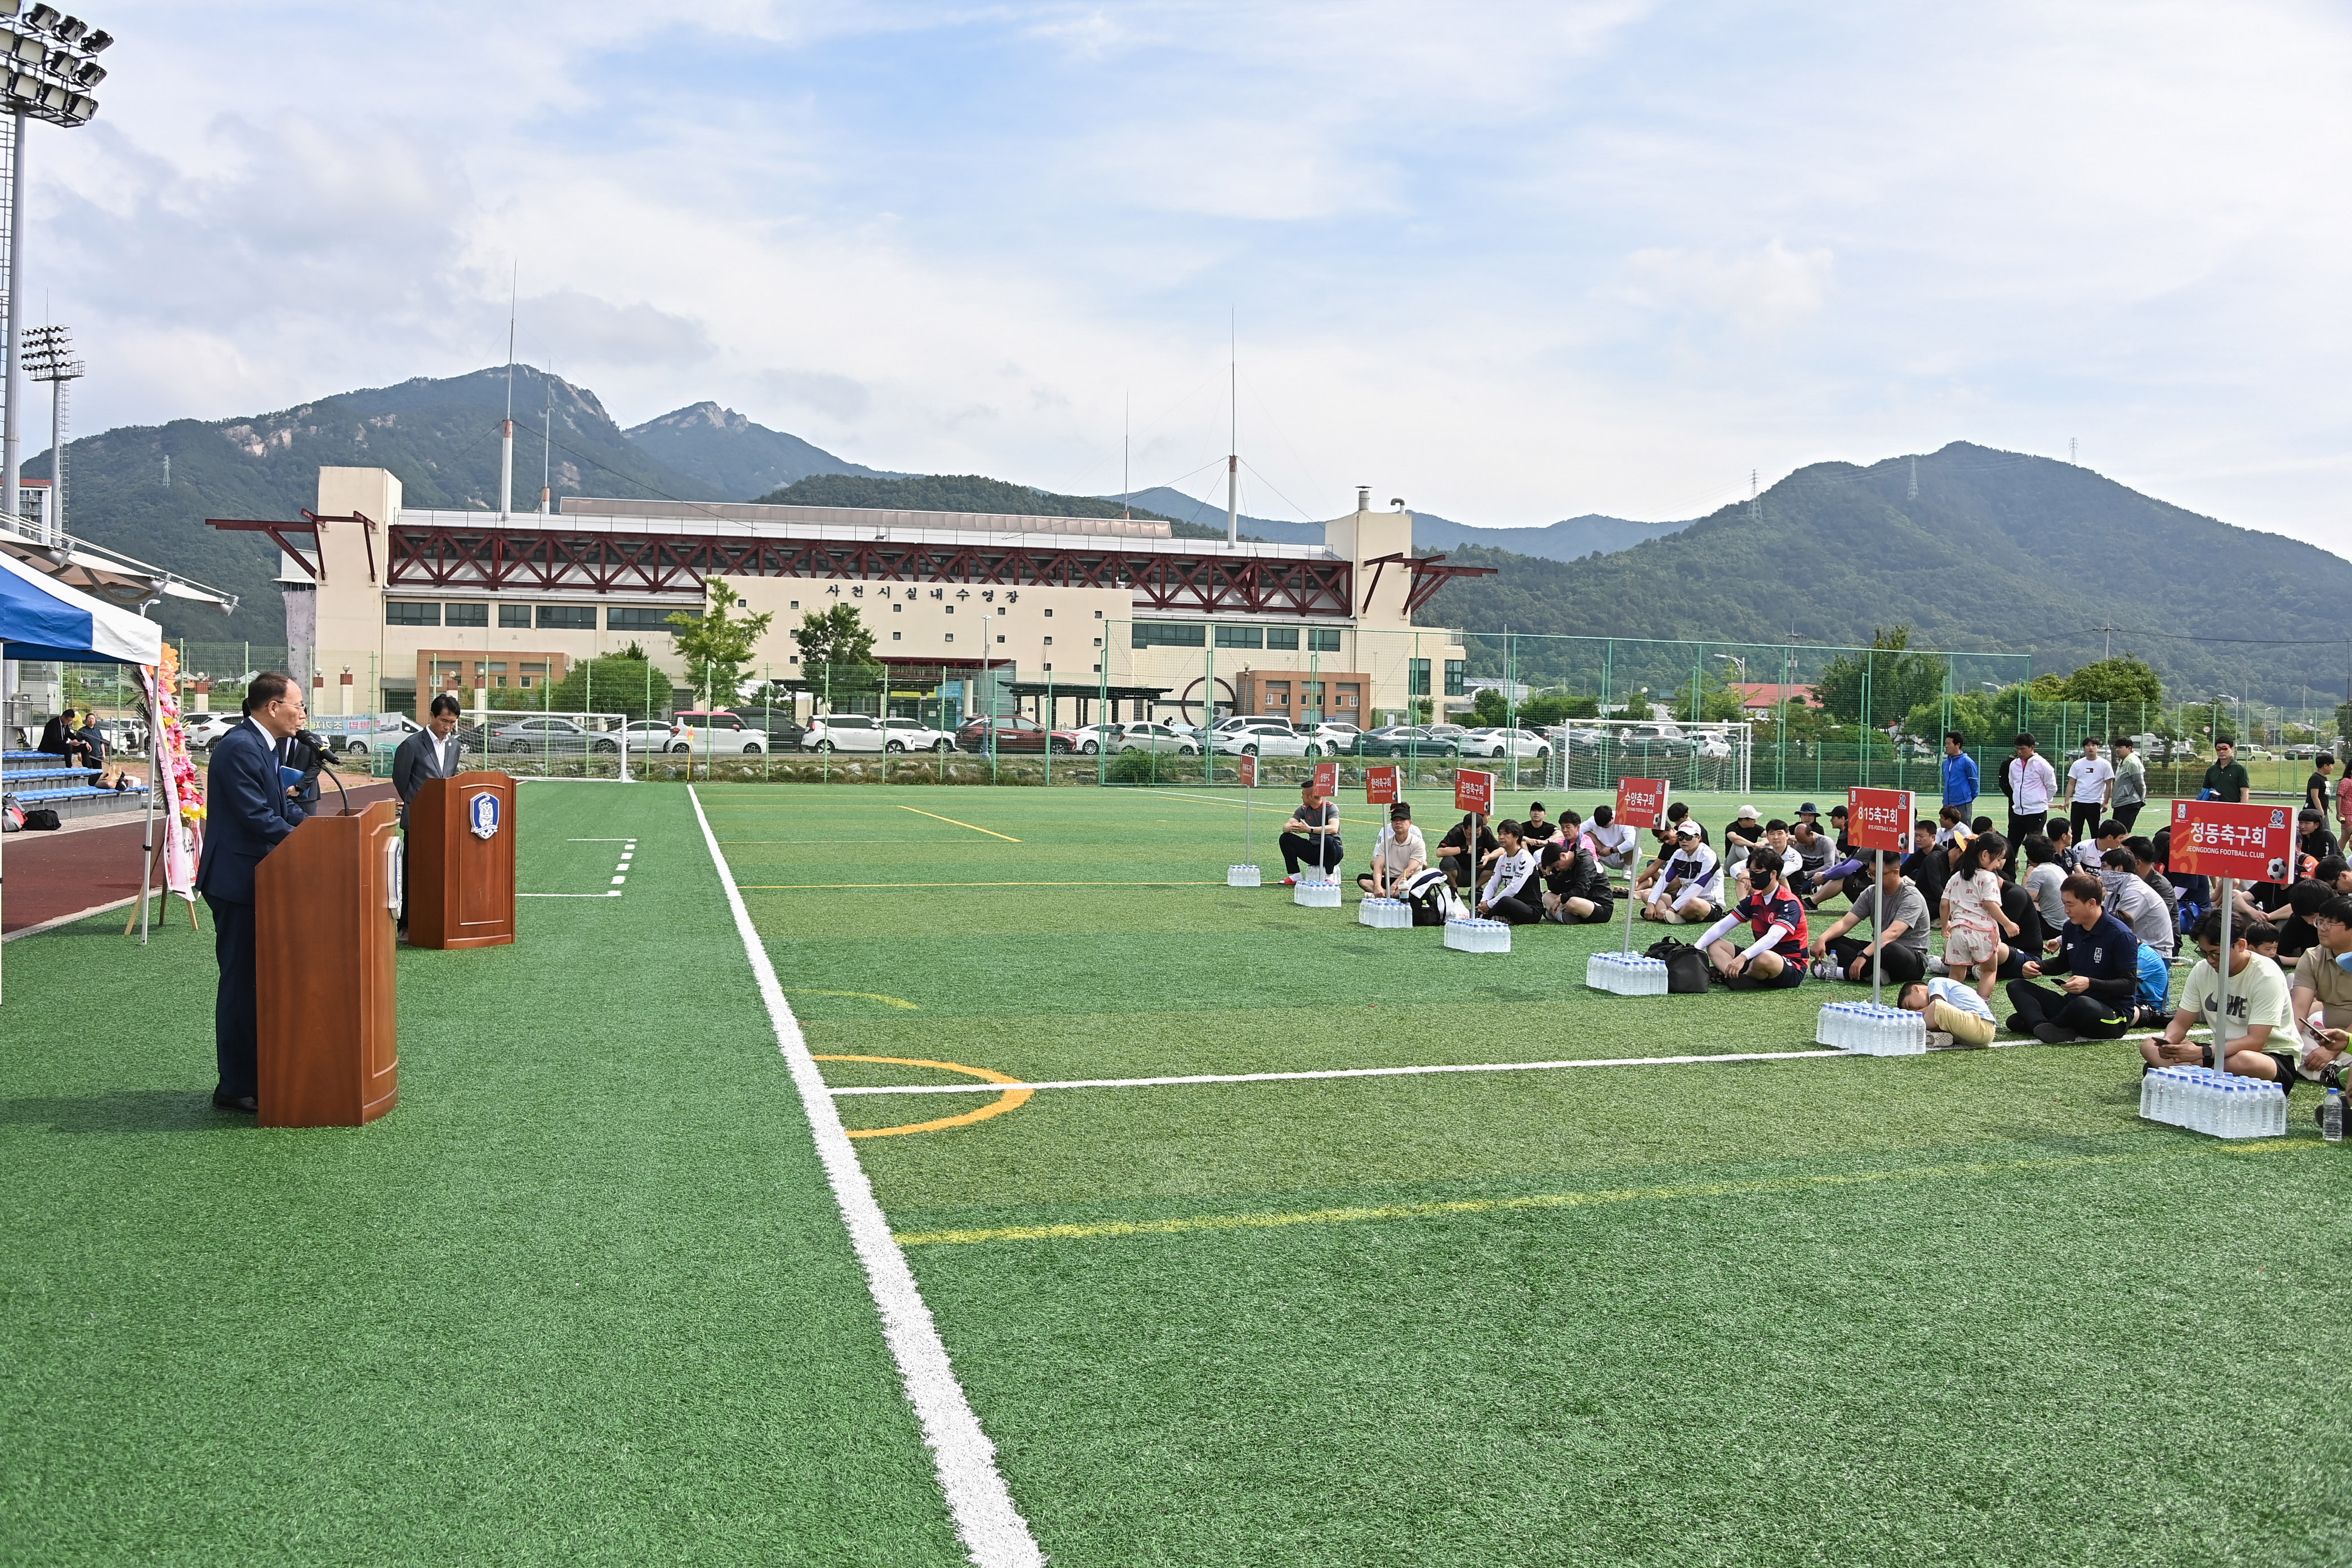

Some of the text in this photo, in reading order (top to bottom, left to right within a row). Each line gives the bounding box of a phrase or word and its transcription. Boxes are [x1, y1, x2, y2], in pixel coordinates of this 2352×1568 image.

[825, 584, 1019, 604] 사천시실내수영장
[1371, 777, 1392, 789] 한려축구회
[1460, 781, 1484, 796] 곤명축구회
[1624, 792, 1655, 808] 수양축구회
[1858, 806, 1897, 826] 815축구회
[2190, 822, 2266, 848] 정동축구회
[2186, 845, 2219, 854] JEONGDONG
[2220, 849, 2248, 857] FOOTBALL
